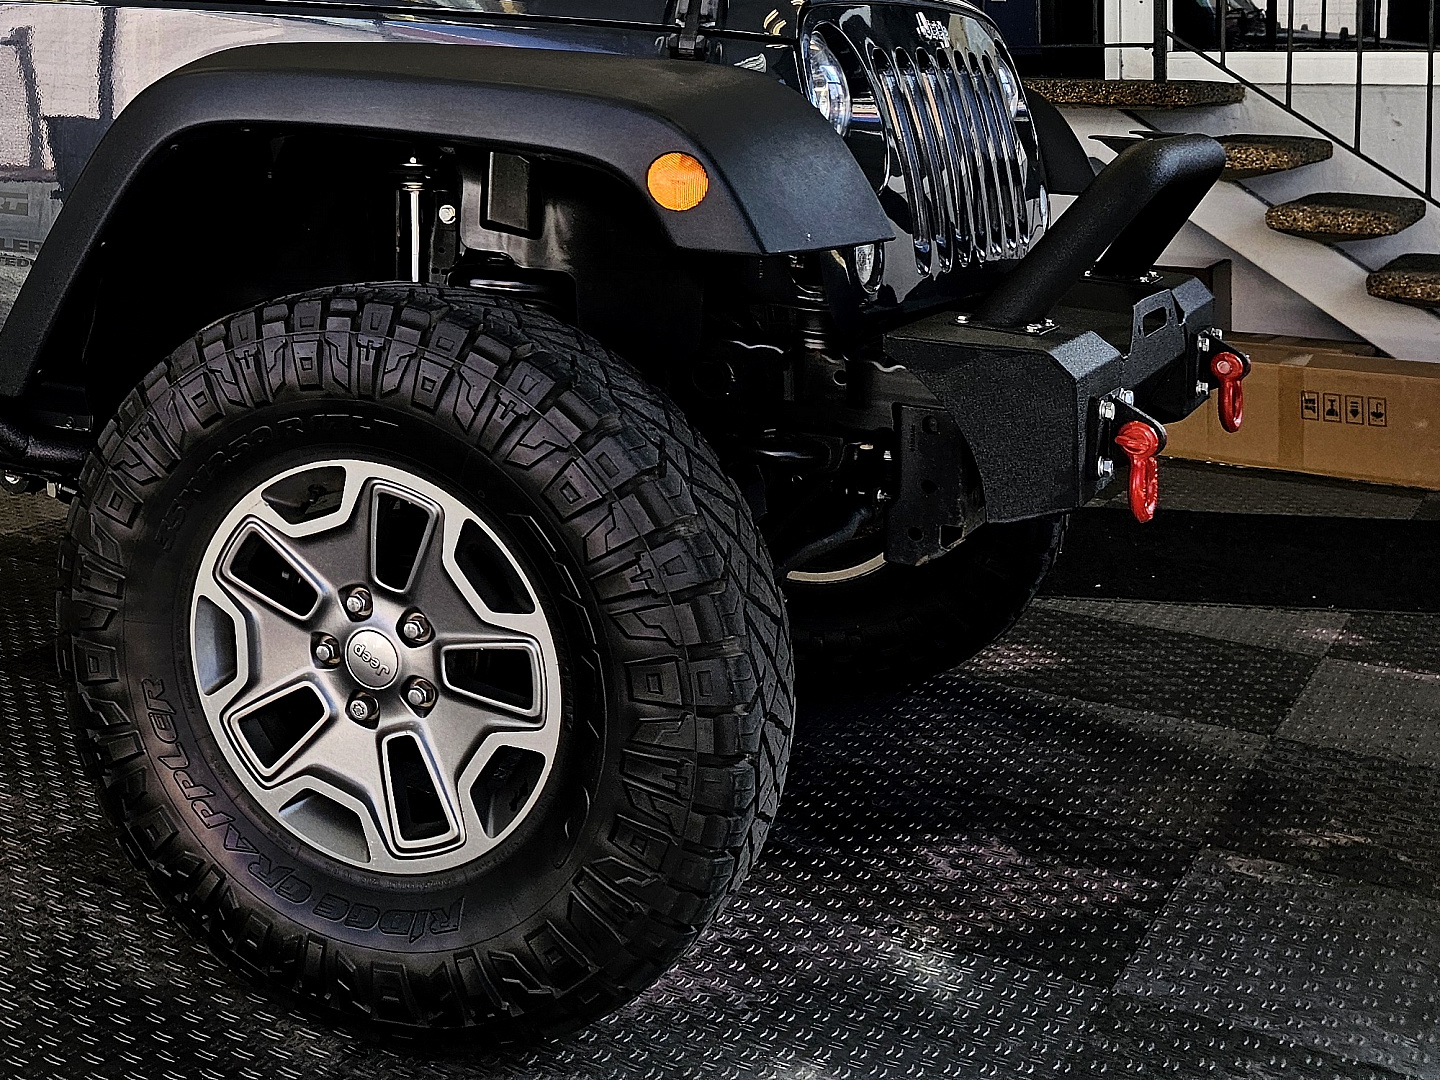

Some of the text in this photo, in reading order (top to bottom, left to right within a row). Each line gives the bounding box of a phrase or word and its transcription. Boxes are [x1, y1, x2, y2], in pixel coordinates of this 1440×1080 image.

[353, 643, 390, 676] Jeep
[141, 678, 466, 943] RIDGE GRAPPLER
